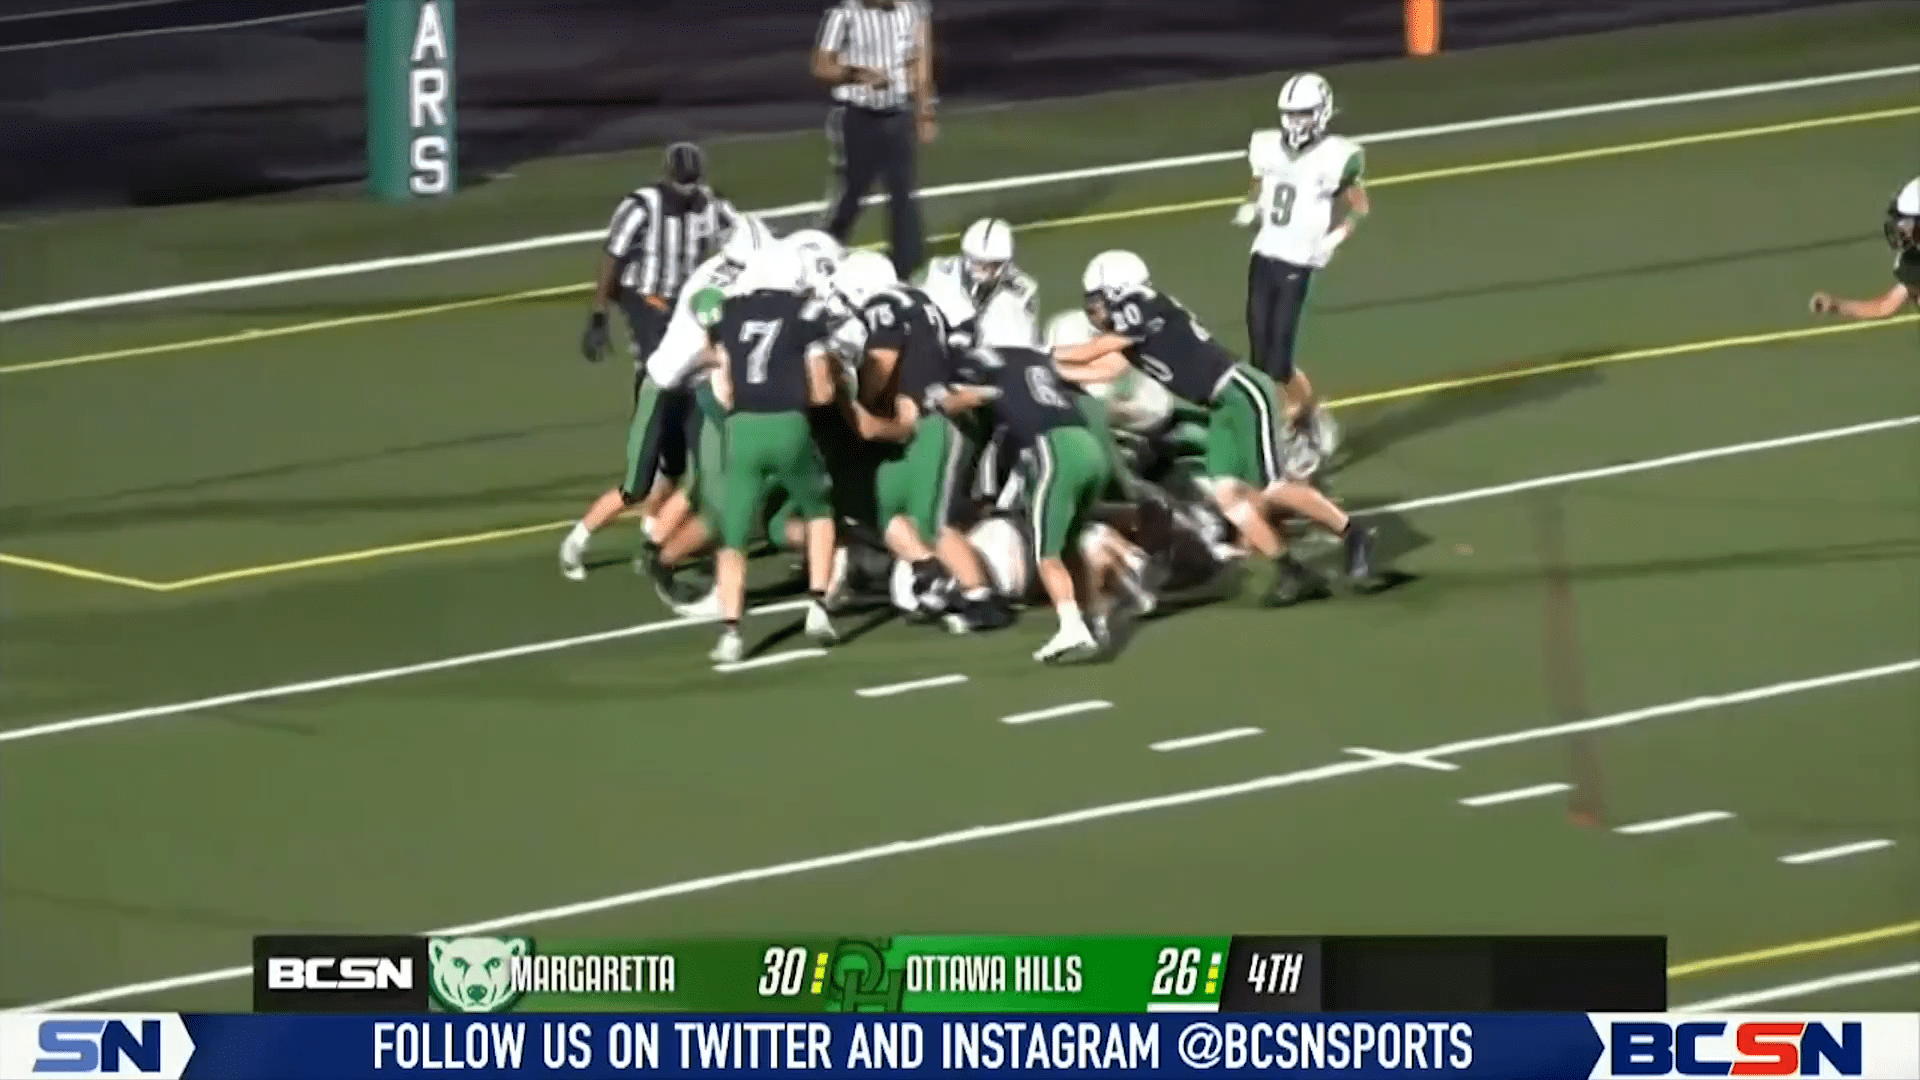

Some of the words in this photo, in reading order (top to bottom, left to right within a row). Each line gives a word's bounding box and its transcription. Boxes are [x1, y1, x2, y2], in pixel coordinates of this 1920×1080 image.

[410, 2, 449, 194] ARS
[1270, 182, 1297, 228] 9
[738, 318, 784, 385] 7
